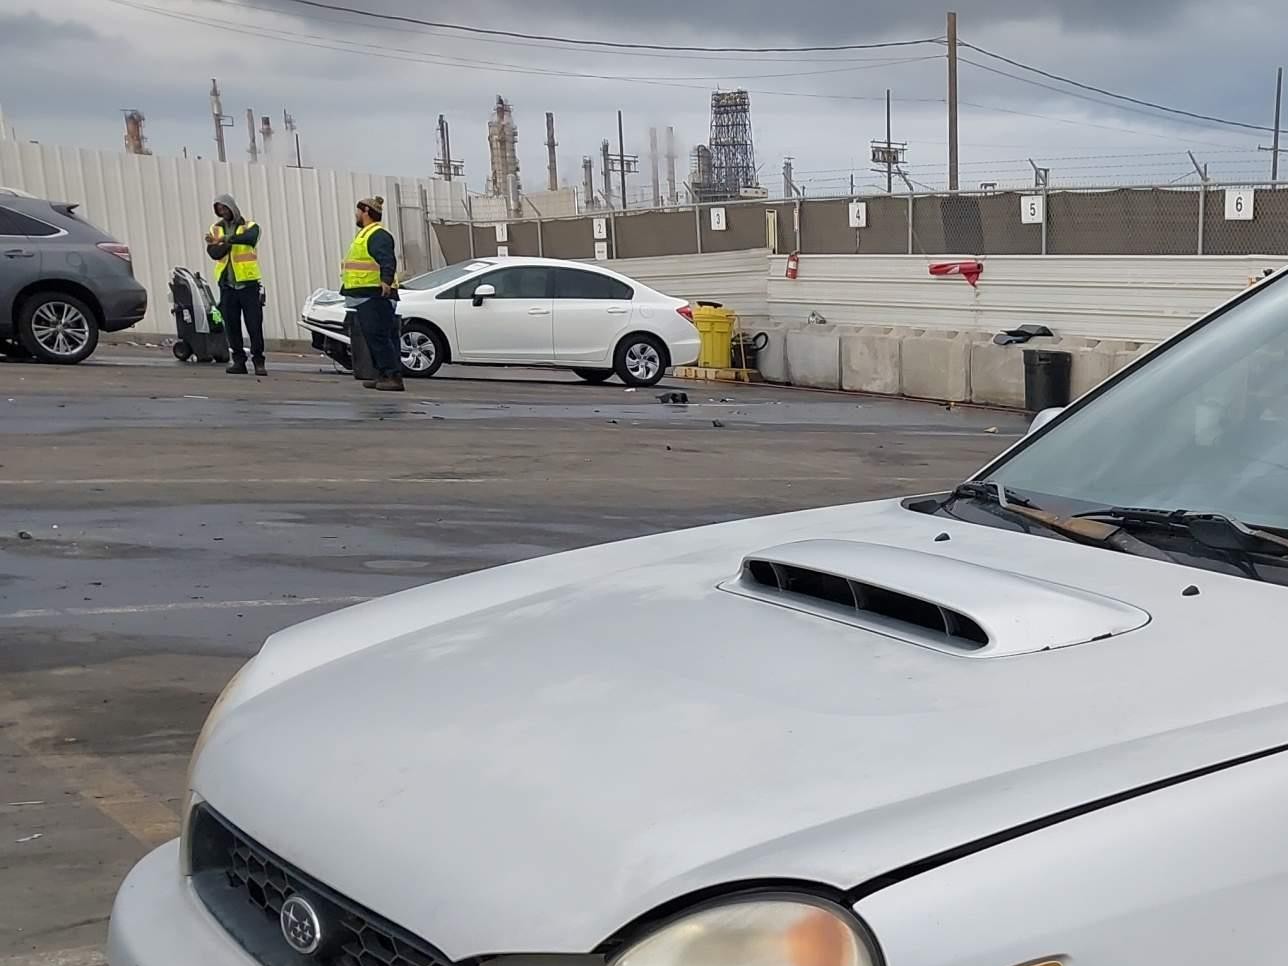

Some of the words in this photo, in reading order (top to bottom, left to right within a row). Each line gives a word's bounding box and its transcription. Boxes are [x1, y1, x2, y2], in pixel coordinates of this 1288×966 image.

[1029, 202, 1036, 217] 5
[1235, 196, 1243, 213] 6
[716, 212, 721, 225] 3
[855, 209, 861, 221] 4
